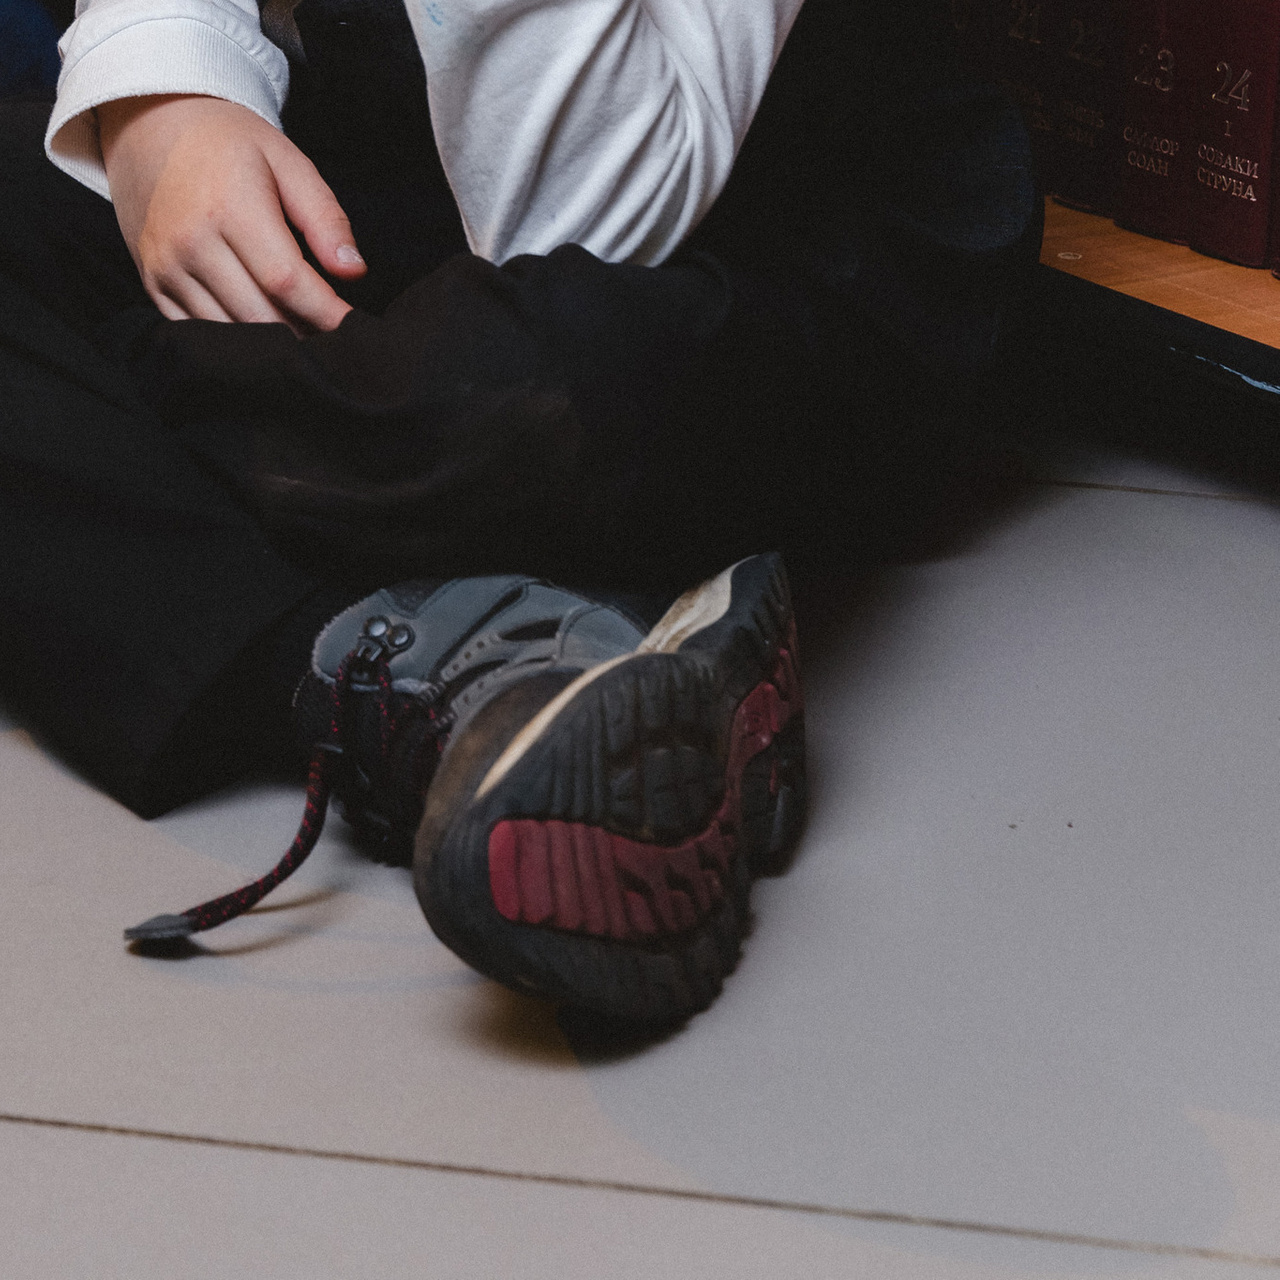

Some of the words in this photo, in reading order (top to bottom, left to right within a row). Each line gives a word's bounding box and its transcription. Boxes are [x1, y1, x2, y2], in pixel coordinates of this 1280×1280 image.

[1133, 42, 1176, 93] 23
[1209, 60, 1254, 113] 24
[1197, 143, 1260, 180] СОБАКИ
[1197, 166, 1258, 203] СТРУНА
